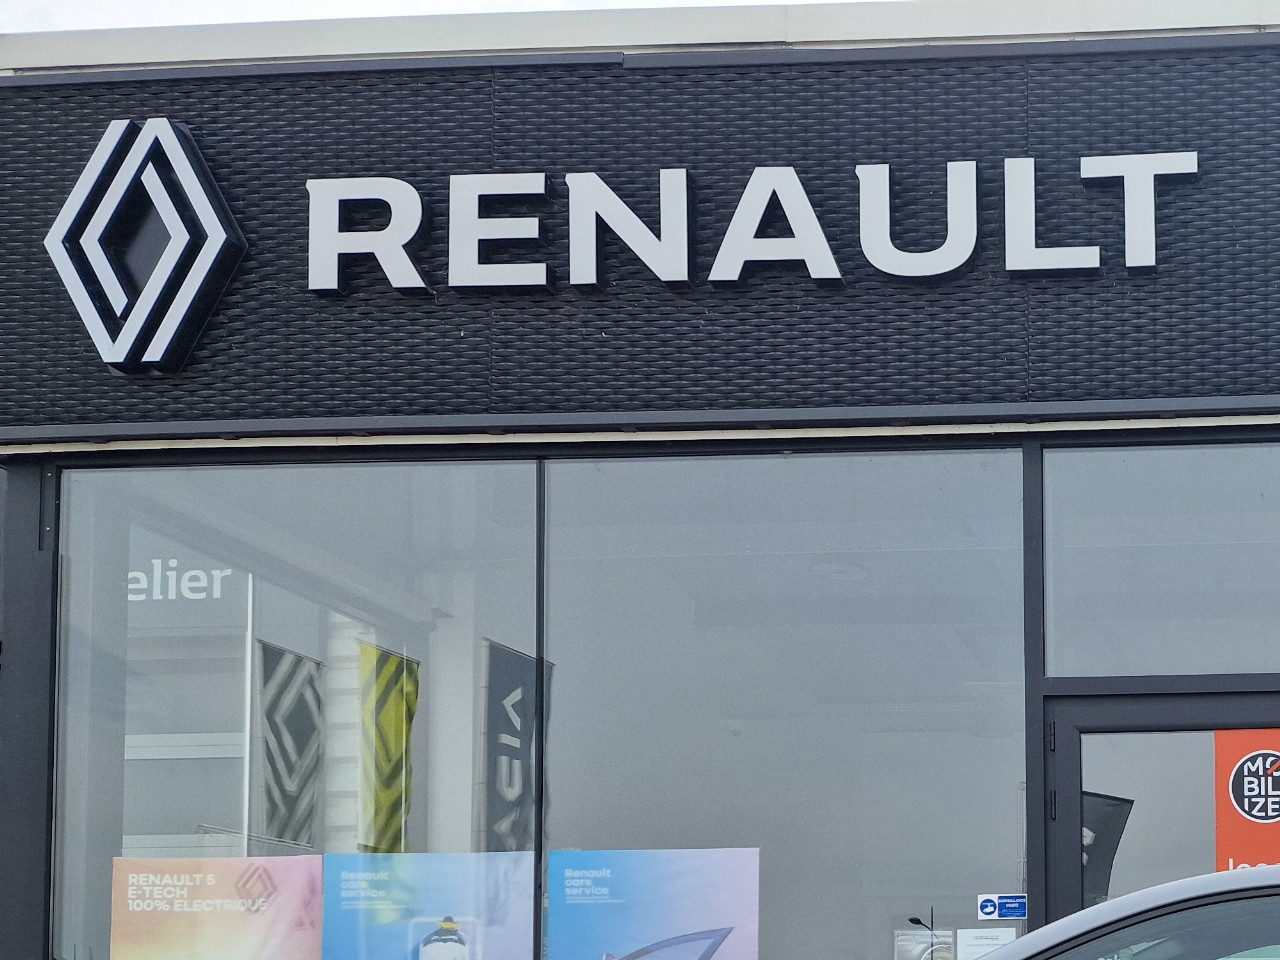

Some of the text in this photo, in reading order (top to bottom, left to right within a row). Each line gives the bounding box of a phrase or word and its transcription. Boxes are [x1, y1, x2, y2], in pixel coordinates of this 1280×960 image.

[305, 151, 1200, 291] RENAULT
[564, 868, 612, 878] Renault
[128, 873, 216, 886] RENAULT 5
[564, 878, 592, 887] care
[127, 886, 188, 898] E-TECH
[564, 886, 609, 896] service
[128, 898, 267, 912] 100% ELECTRIQUE
